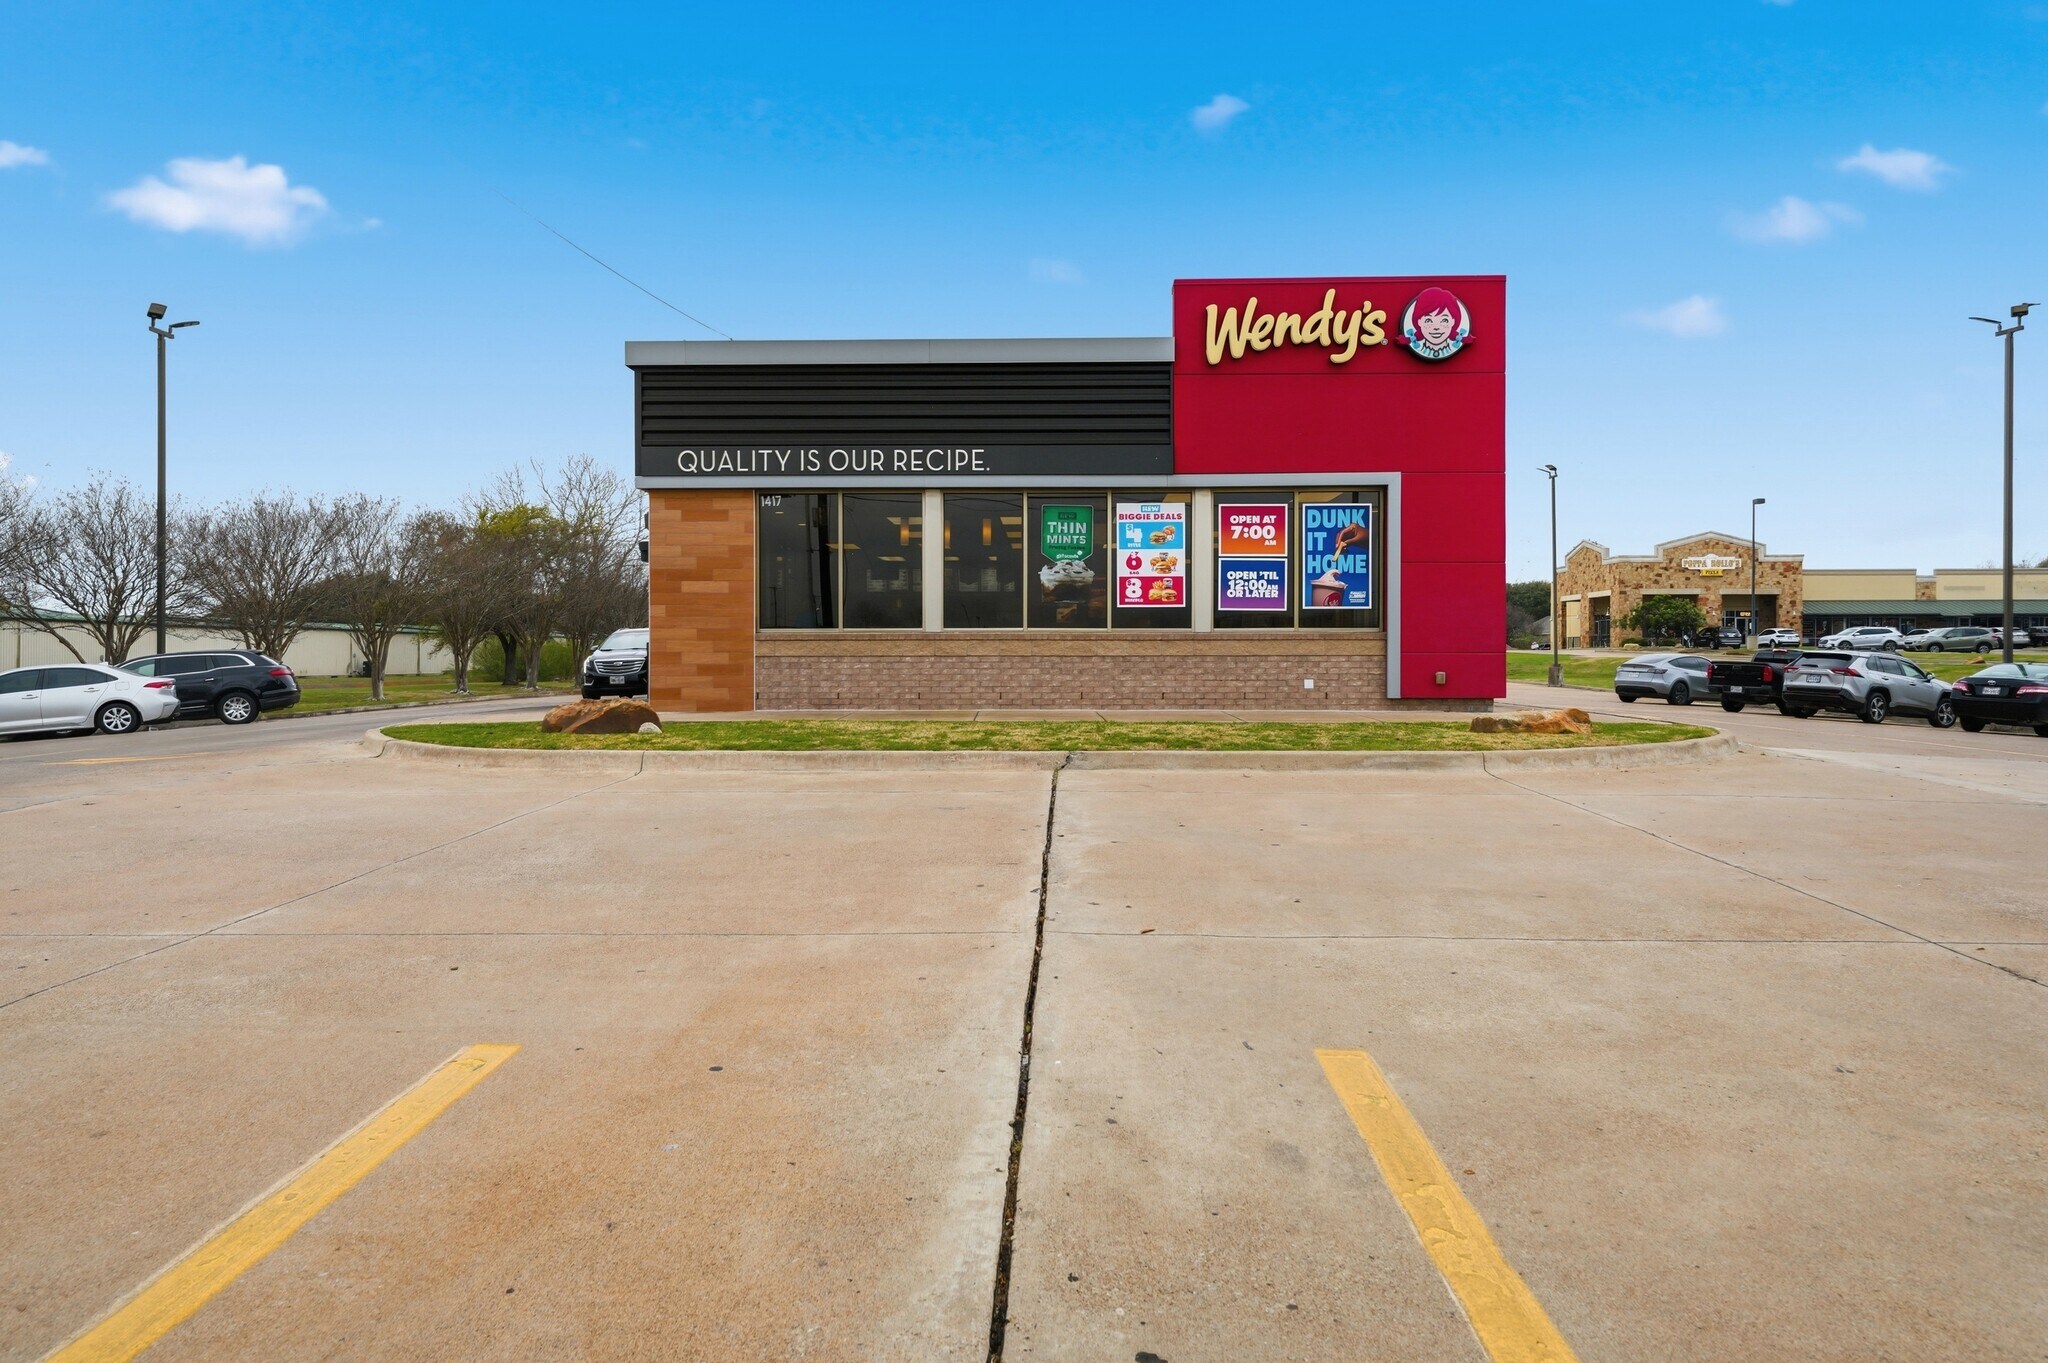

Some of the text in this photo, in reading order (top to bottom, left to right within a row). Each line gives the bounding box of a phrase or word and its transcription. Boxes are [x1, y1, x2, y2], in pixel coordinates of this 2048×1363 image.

[1206, 288, 1387, 365] Wendy's
[677, 449, 991, 473] QUALITY IS OUR RECIPE.
[760, 496, 782, 507] 1417
[1230, 515, 1277, 524] OPEN AT
[1307, 509, 1366, 528] DUNK
[1047, 521, 1087, 534] THIN
[1230, 525, 1276, 540] 7:00
[1046, 535, 1087, 544] MINTS
[1307, 531, 1327, 551] IT
[1307, 554, 1367, 574] HOME
[1226, 570, 1257, 580] OPEN
[1226, 589, 1279, 598] OR LATER
